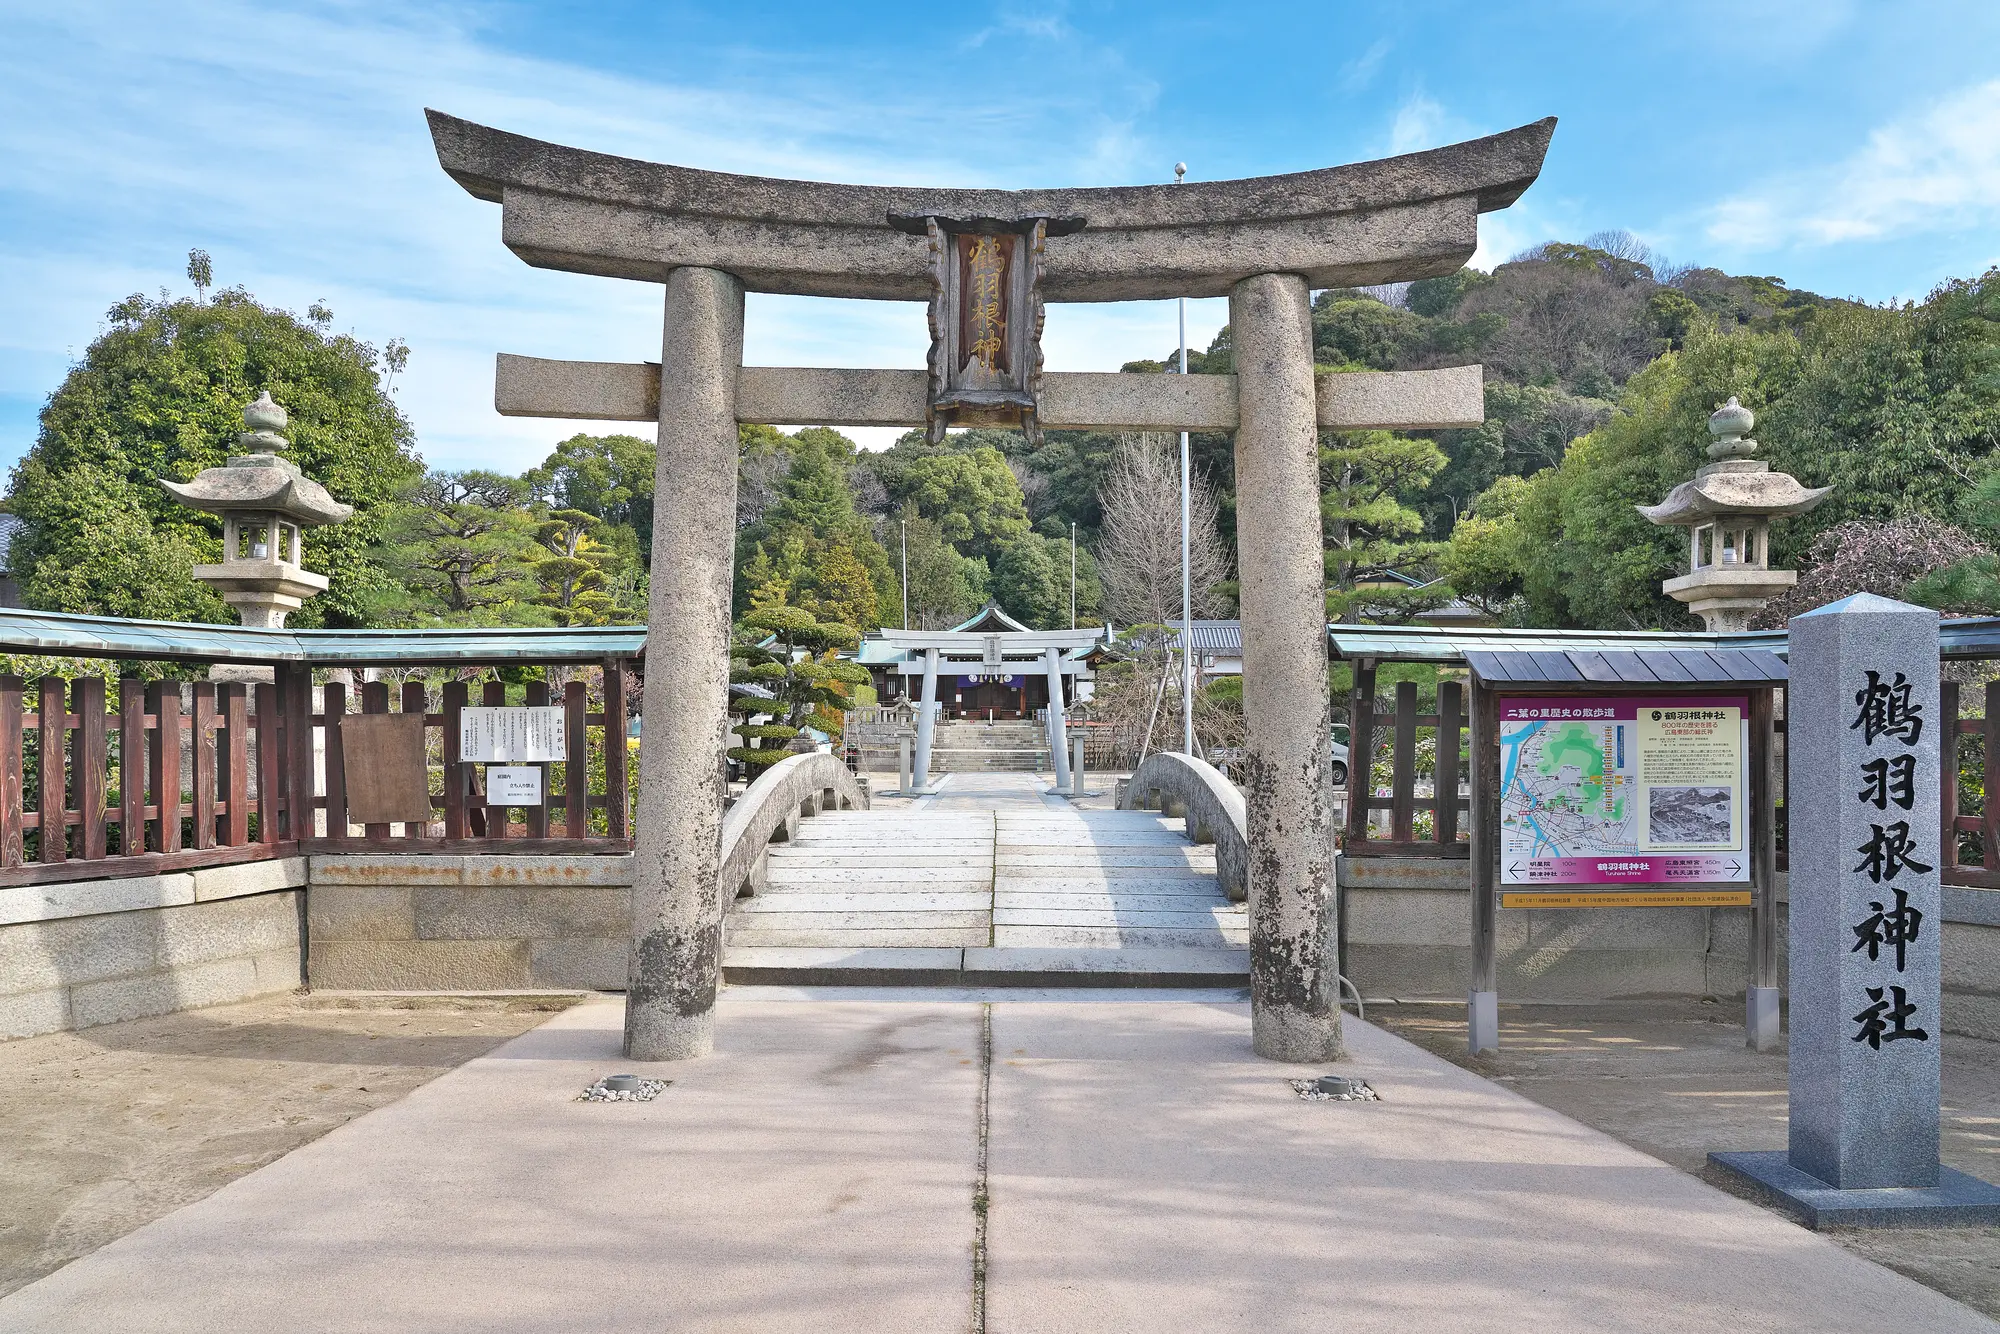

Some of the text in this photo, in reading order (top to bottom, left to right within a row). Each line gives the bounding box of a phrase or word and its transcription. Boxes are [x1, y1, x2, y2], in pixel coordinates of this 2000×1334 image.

[968, 238, 1006, 377] 鶴羽根神
[1507, 708, 1615, 718] 二葉の里歴史の散歩道
[1664, 711, 1726, 720] 鶴羽根神社
[1850, 670, 1934, 1051] 鶴羽根神社
[1597, 862, 1650, 871] 鶴羽根神社
